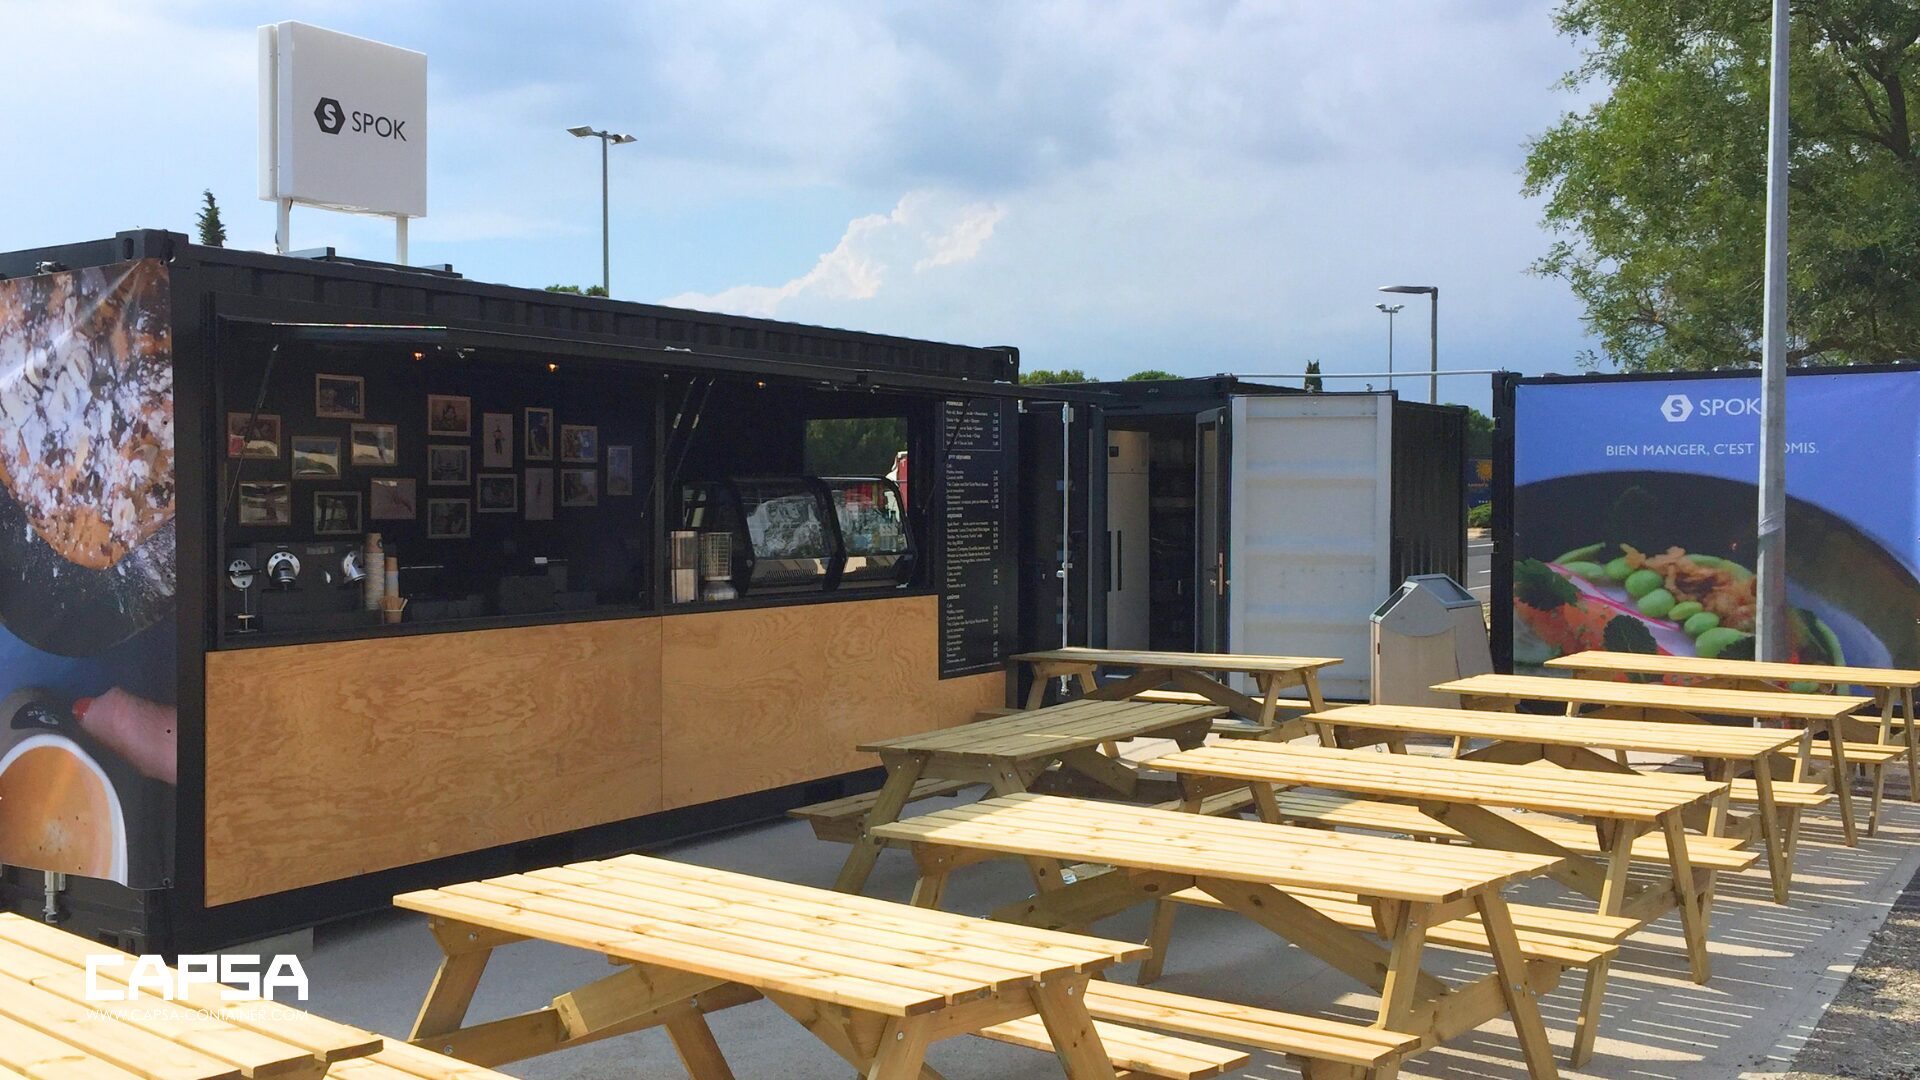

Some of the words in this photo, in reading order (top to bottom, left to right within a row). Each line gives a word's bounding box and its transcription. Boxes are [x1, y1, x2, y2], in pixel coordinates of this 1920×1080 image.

[352, 111, 407, 142] SPOK
[1699, 398, 1761, 416] SPOK
[1606, 443, 1639, 456] BIEN
[1713, 443, 1754, 455] C'EST
